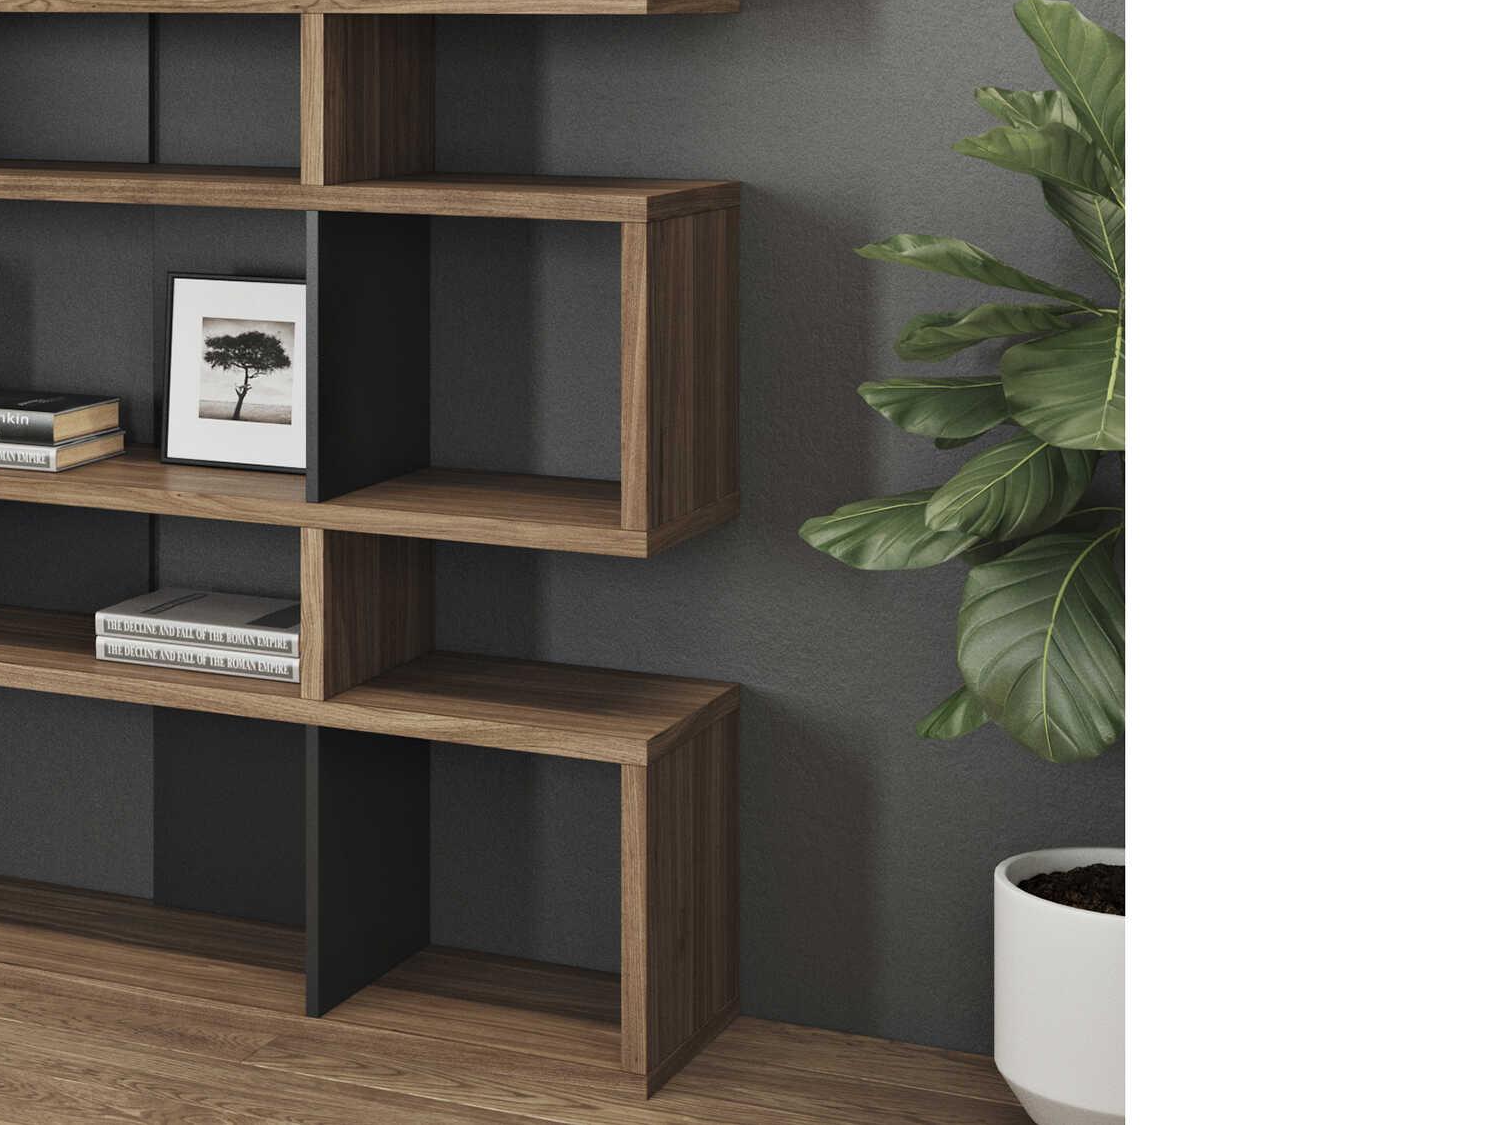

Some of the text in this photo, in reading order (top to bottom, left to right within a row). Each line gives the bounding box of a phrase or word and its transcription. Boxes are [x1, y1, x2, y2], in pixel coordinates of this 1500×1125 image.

[16, 451, 47, 464] EMPIRE
[107, 618, 288, 650] THE DECLINE AND FALL OF THE ROMAN EMPIRE
[107, 643, 289, 675] THE DECLINE AND FALL OF THE ROMAN EMPIRE
